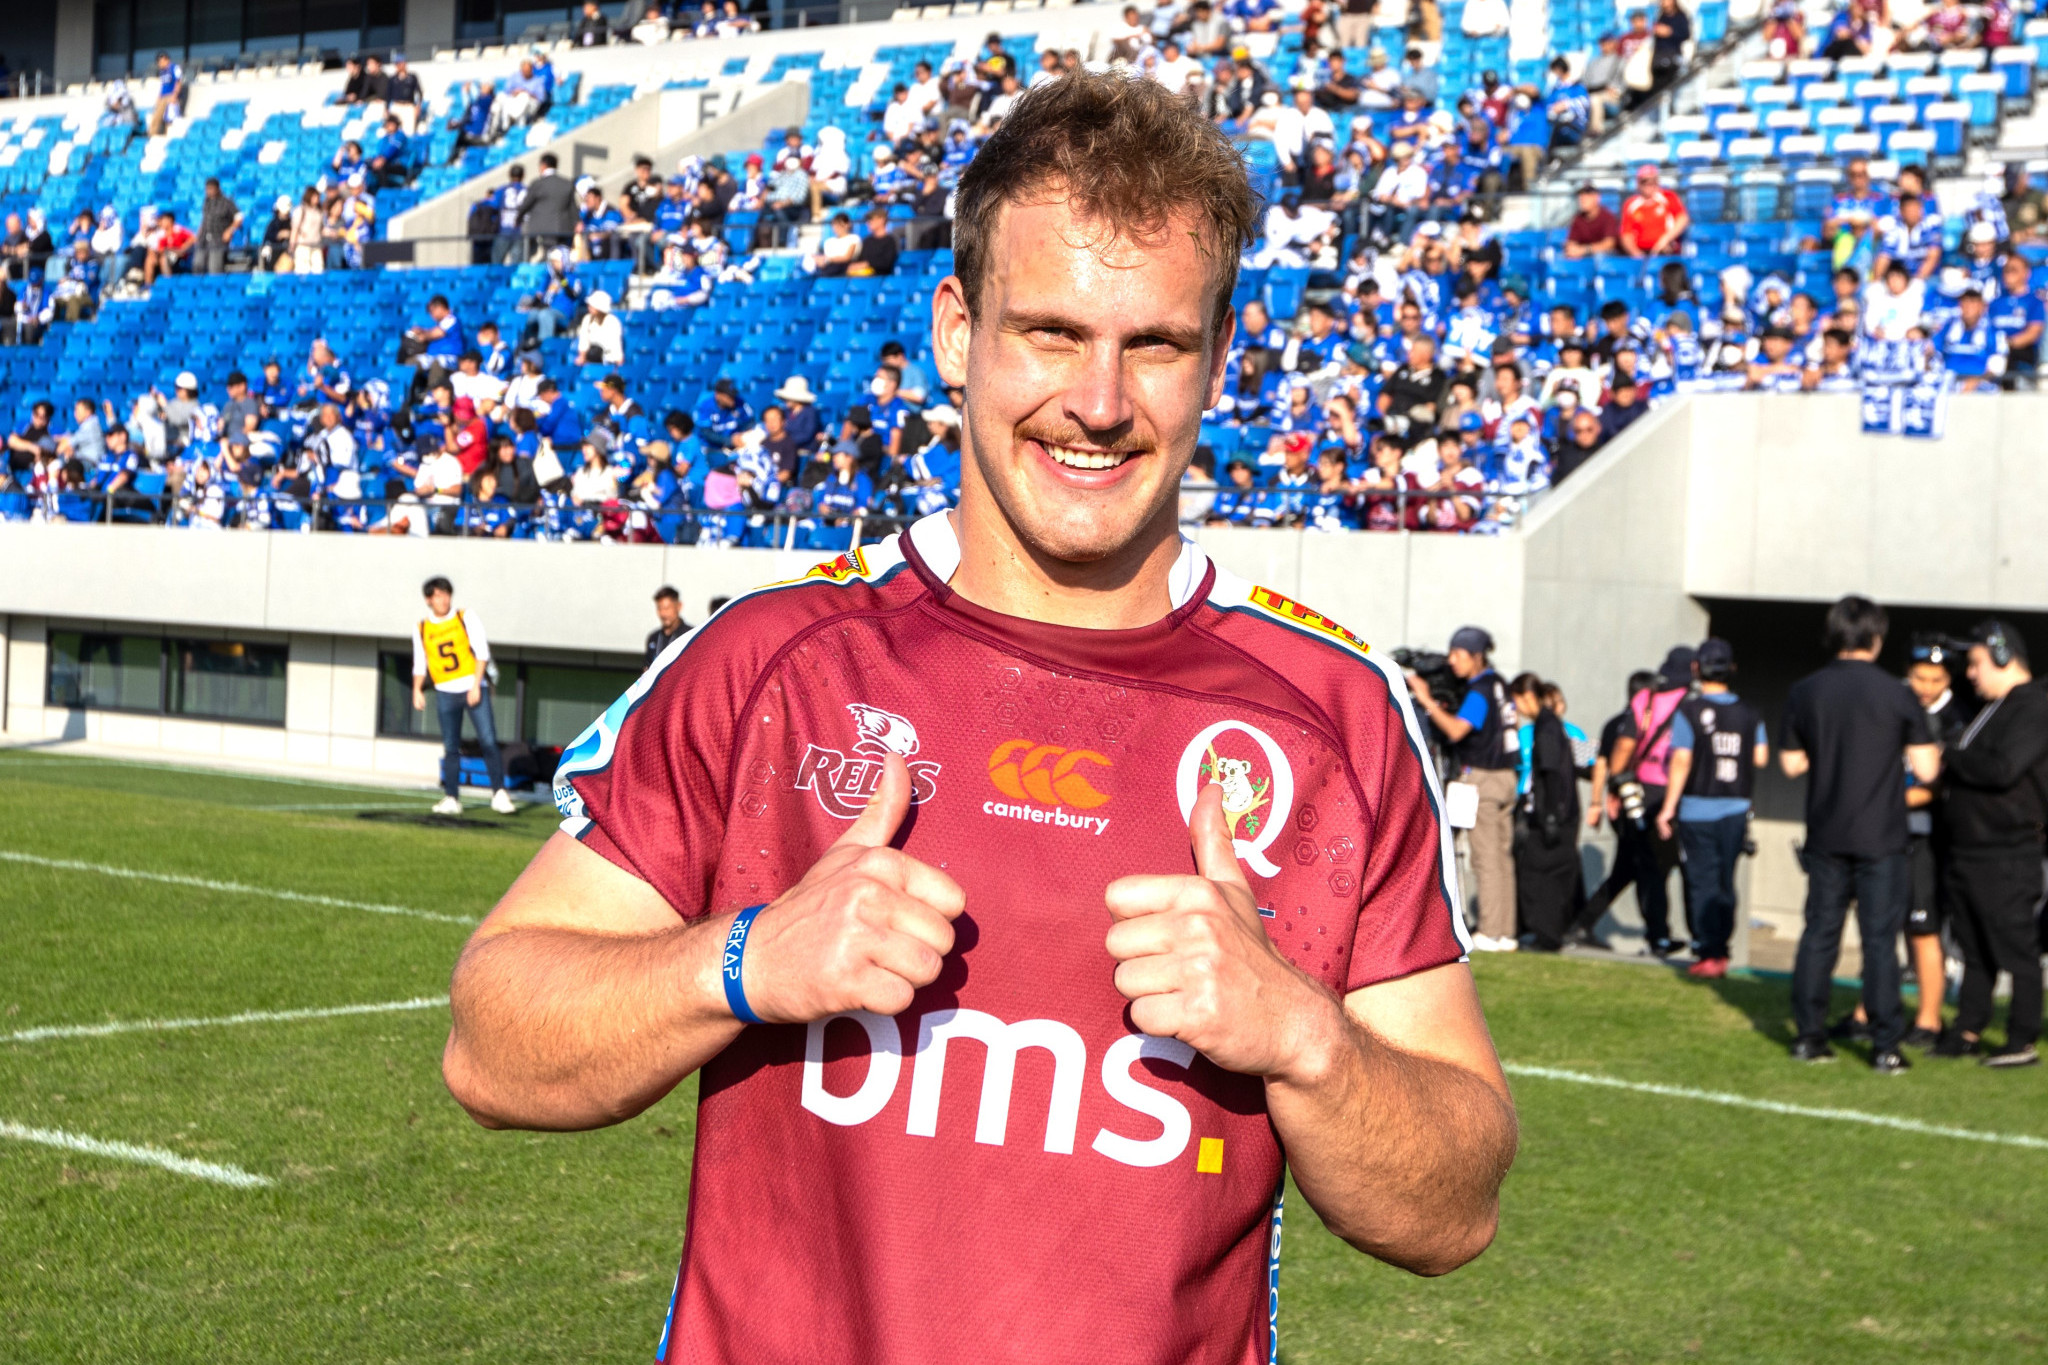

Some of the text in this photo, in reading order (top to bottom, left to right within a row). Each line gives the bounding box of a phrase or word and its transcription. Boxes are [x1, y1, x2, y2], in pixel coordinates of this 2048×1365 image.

[438, 641, 459, 672] 5
[1176, 719, 1295, 879] Q
[982, 801, 1110, 835] canterbury
